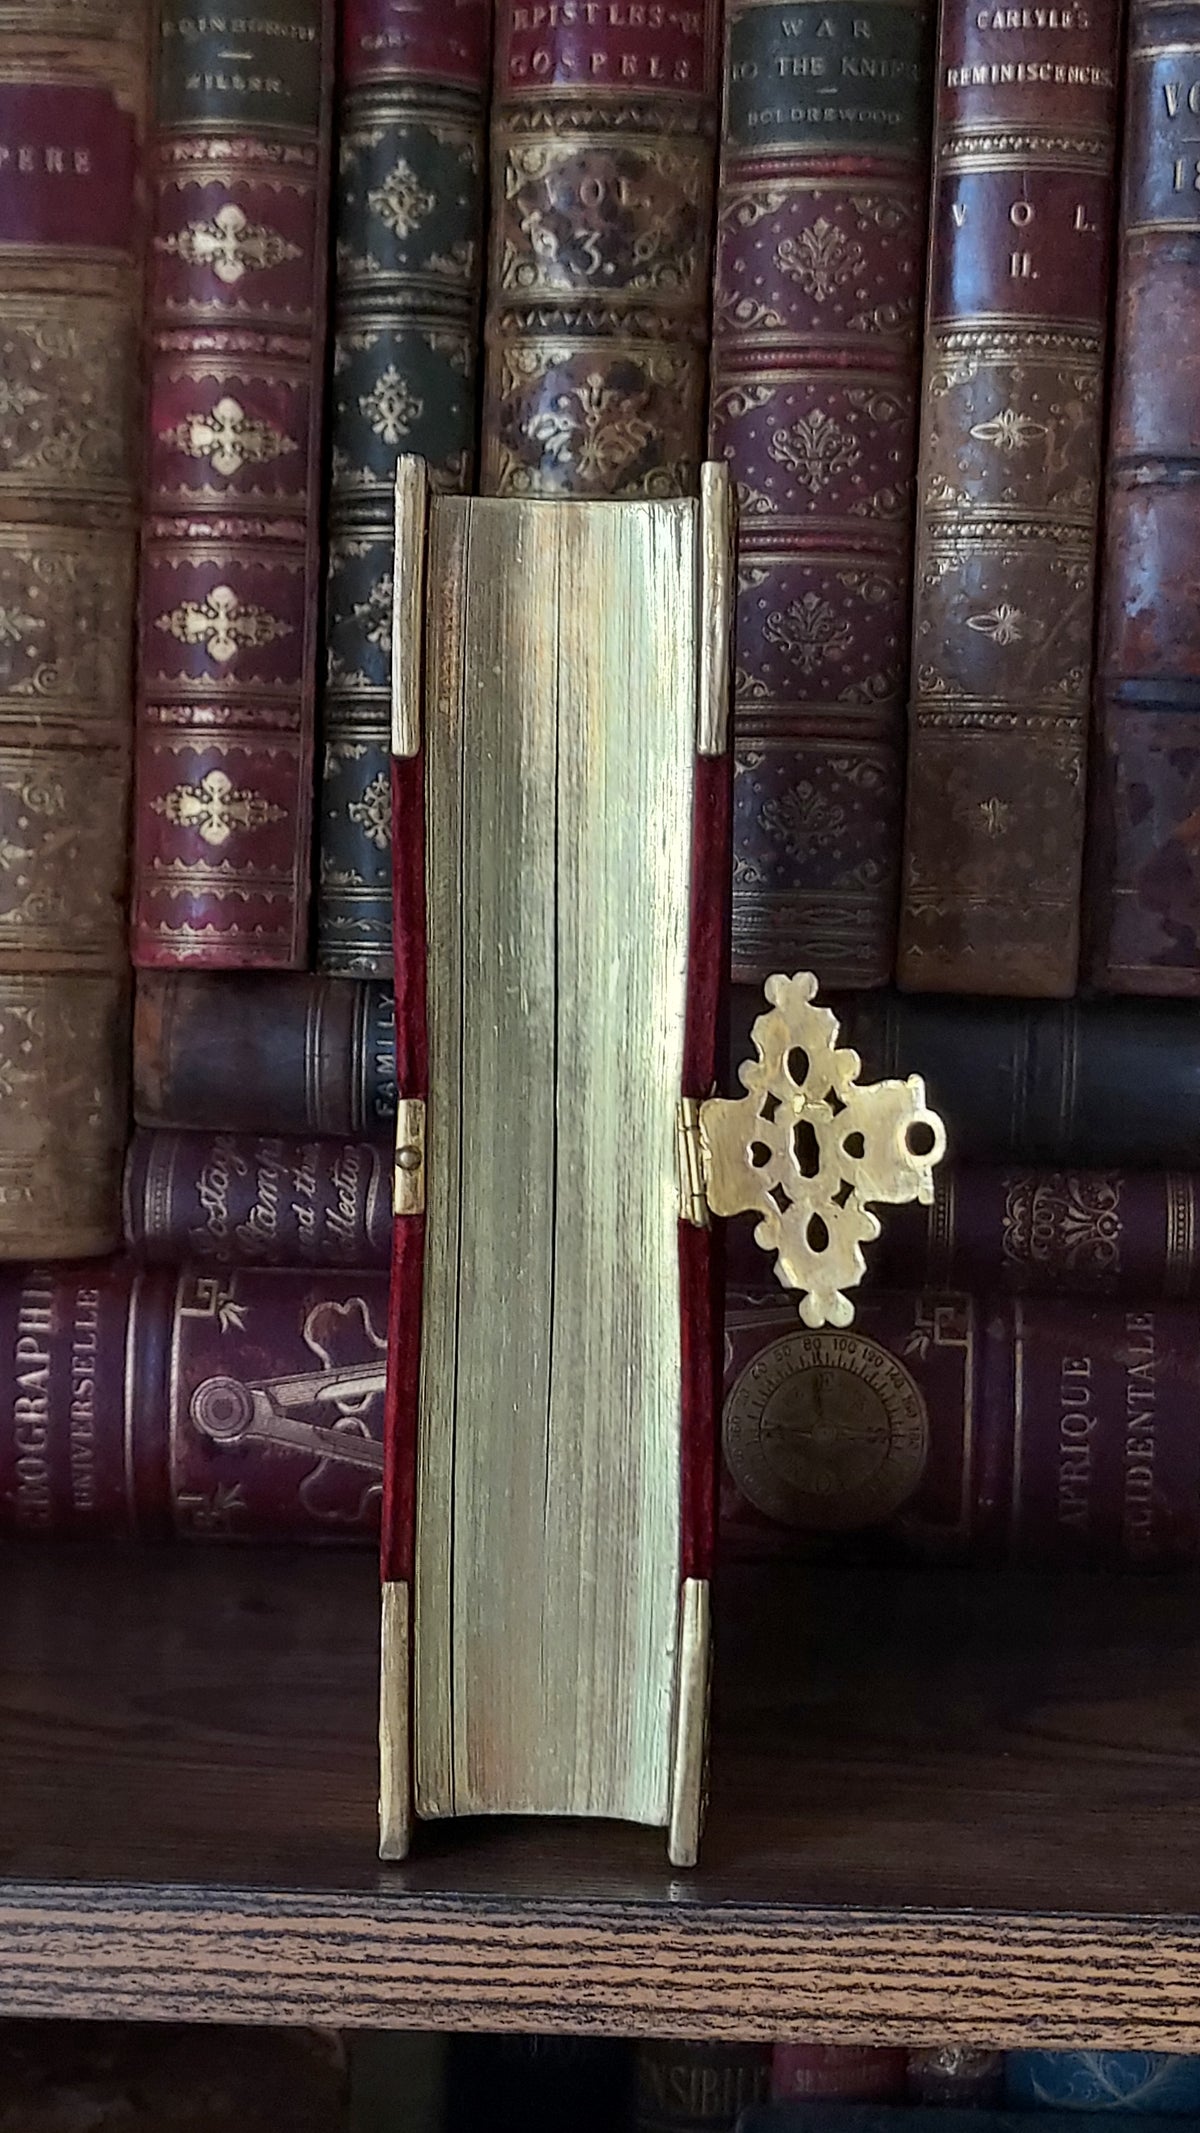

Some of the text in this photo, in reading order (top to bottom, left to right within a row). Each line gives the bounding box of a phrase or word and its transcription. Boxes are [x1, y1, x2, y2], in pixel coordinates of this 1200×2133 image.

[782, 18, 871, 38] WAR
[976, 2, 1089, 29] CARLYLE'S
[510, 47, 690, 81] GOSPELS
[778, 56, 826, 77] THE
[1010, 251, 1039, 279] II.
[374, 992, 396, 1116] FAMILY
[803, 1337, 822, 1351] 80
[833, 1337, 857, 1354] 100
[862, 1347, 885, 1369] 120
[69, 1286, 101, 1511] UNIVERSELLE
[1057, 1356, 1097, 1530] AFRIQUE
